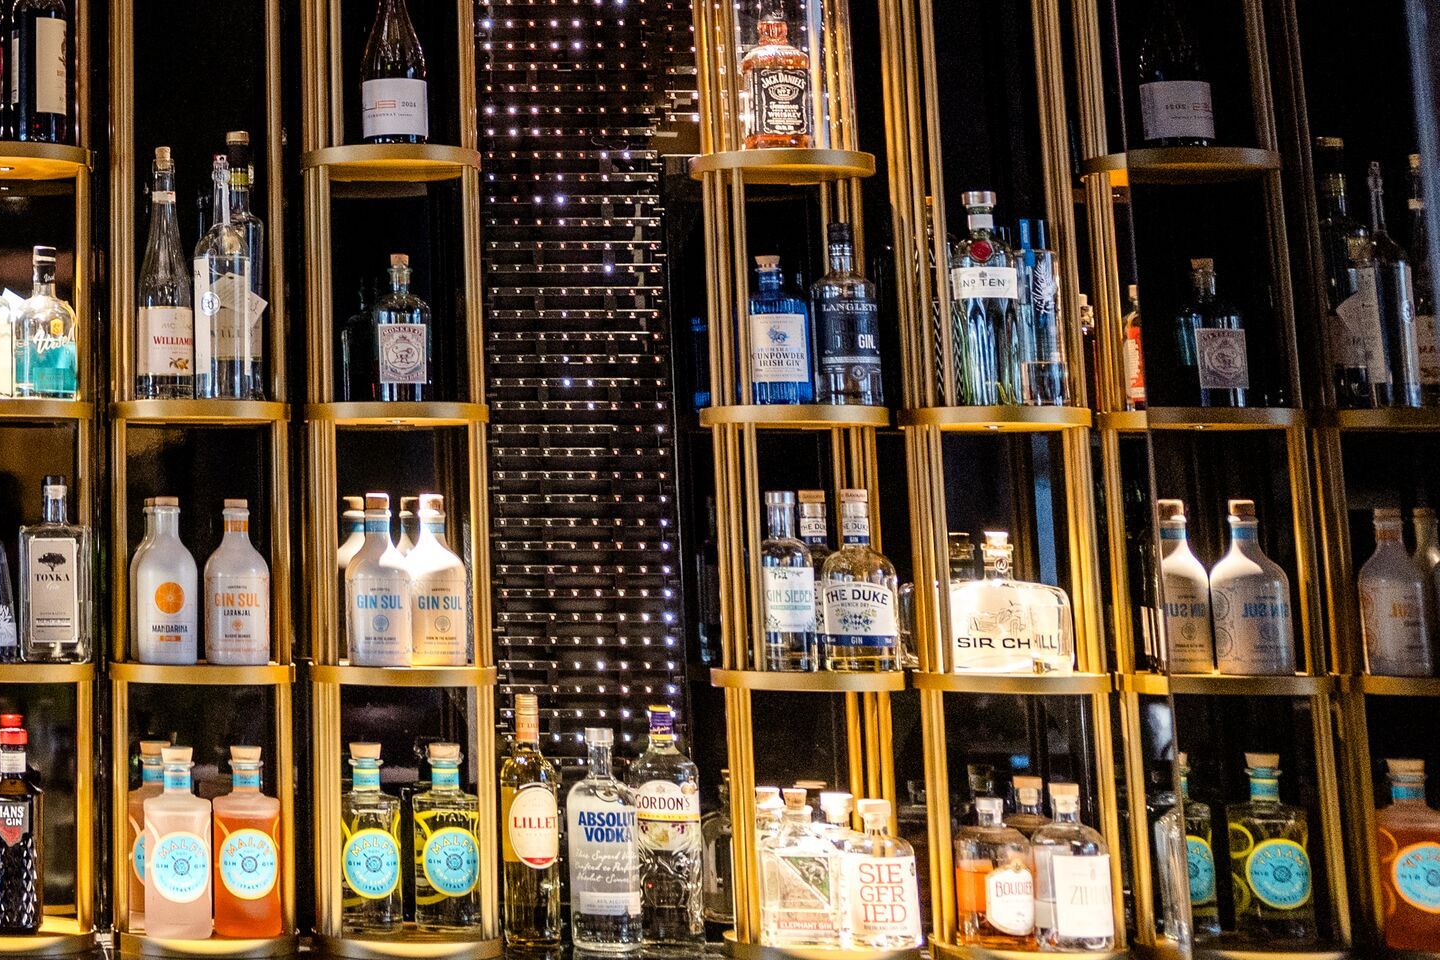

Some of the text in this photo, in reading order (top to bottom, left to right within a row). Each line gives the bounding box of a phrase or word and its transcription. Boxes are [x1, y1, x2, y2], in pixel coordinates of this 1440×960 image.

[762, 72, 807, 90] JACK DANIEL'S
[768, 111, 801, 119] WHISKEY
[981, 278, 1005, 288] TEN
[858, 333, 876, 349] GIN.
[752, 352, 805, 360] GUNPOWDER
[759, 359, 801, 367] IRISH GIN
[34, 574, 70, 582] TONKA
[214, 592, 260, 607] GIN SUL
[357, 594, 403, 609] GIN SUL
[418, 595, 463, 610] GIN SUL
[766, 590, 781, 602] GIN
[826, 589, 889, 606] THE DUKE
[223, 609, 251, 617] LARANJAL
[152, 624, 188, 633] MANDARINA
[851, 636, 863, 645] GIN
[957, 634, 1058, 650] SIR CHILL
[635, 793, 691, 811] GORDON'S
[6, 817, 23, 826] GIN
[513, 816, 557, 829] LILLET
[578, 810, 635, 827] ABSOLUT
[584, 826, 633, 843] VODKA
[160, 839, 205, 859] MALFY
[226, 836, 271, 857] MALFY
[351, 836, 395, 856] MALFY
[432, 836, 474, 855] MALFY
[859, 863, 903, 885] SIE
[860, 885, 905, 902] GFR
[863, 903, 907, 924] IED
